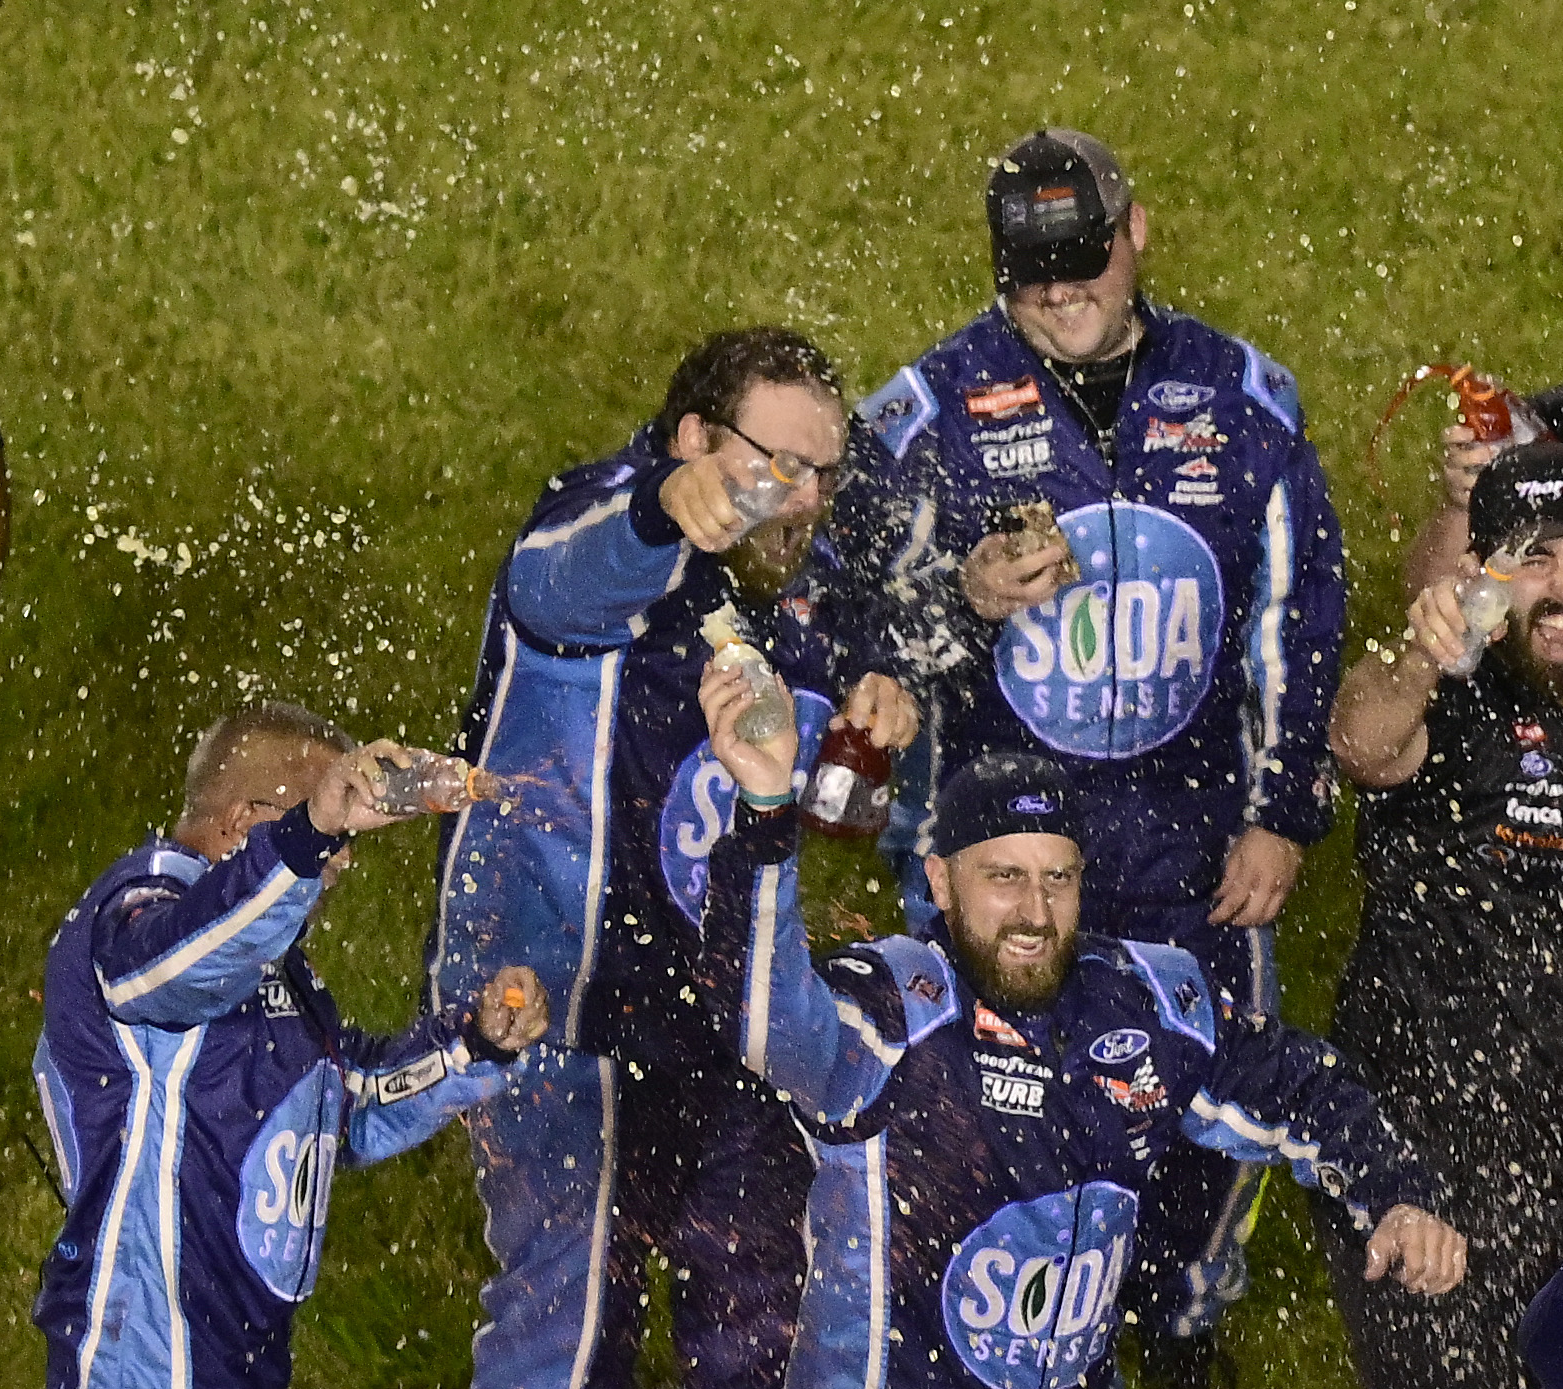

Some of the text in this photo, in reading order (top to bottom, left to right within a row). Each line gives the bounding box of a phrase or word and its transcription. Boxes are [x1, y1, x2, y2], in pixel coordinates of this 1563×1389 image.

[983, 440, 1051, 471] CURB
[1012, 577, 1205, 684] SODA
[1036, 680, 1184, 721] SENSE
[982, 1075, 1045, 1108] CURB
[973, 1337, 1101, 1369] SENSE
